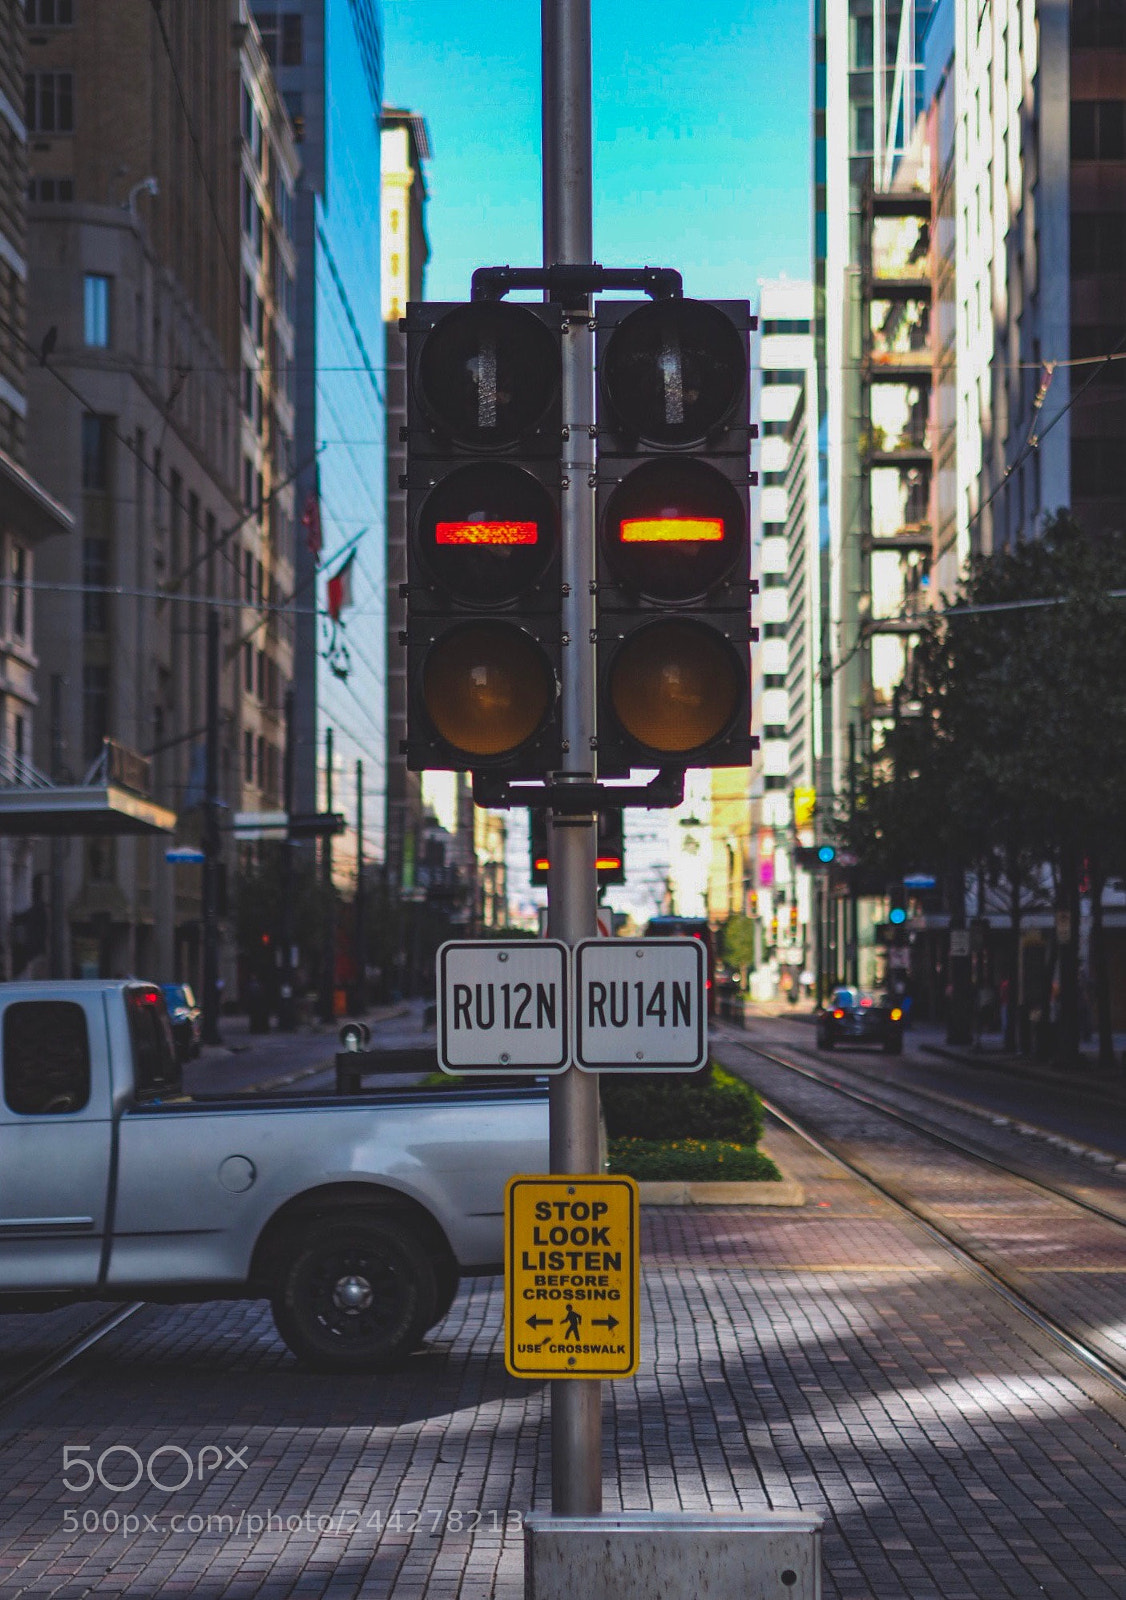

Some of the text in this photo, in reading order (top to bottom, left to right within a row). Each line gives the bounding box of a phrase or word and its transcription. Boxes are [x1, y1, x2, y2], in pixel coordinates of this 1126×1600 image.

[453, 982, 556, 1031] RU12N
[588, 981, 691, 1028] RU14N
[535, 1201, 609, 1222] STOP
[533, 1226, 611, 1246] LOOK
[522, 1251, 622, 1271] LISTEN
[534, 1275, 609, 1287] BEFORE
[522, 1288, 621, 1301] CROSSING
[517, 1344, 626, 1354] USE CROSSWALK
